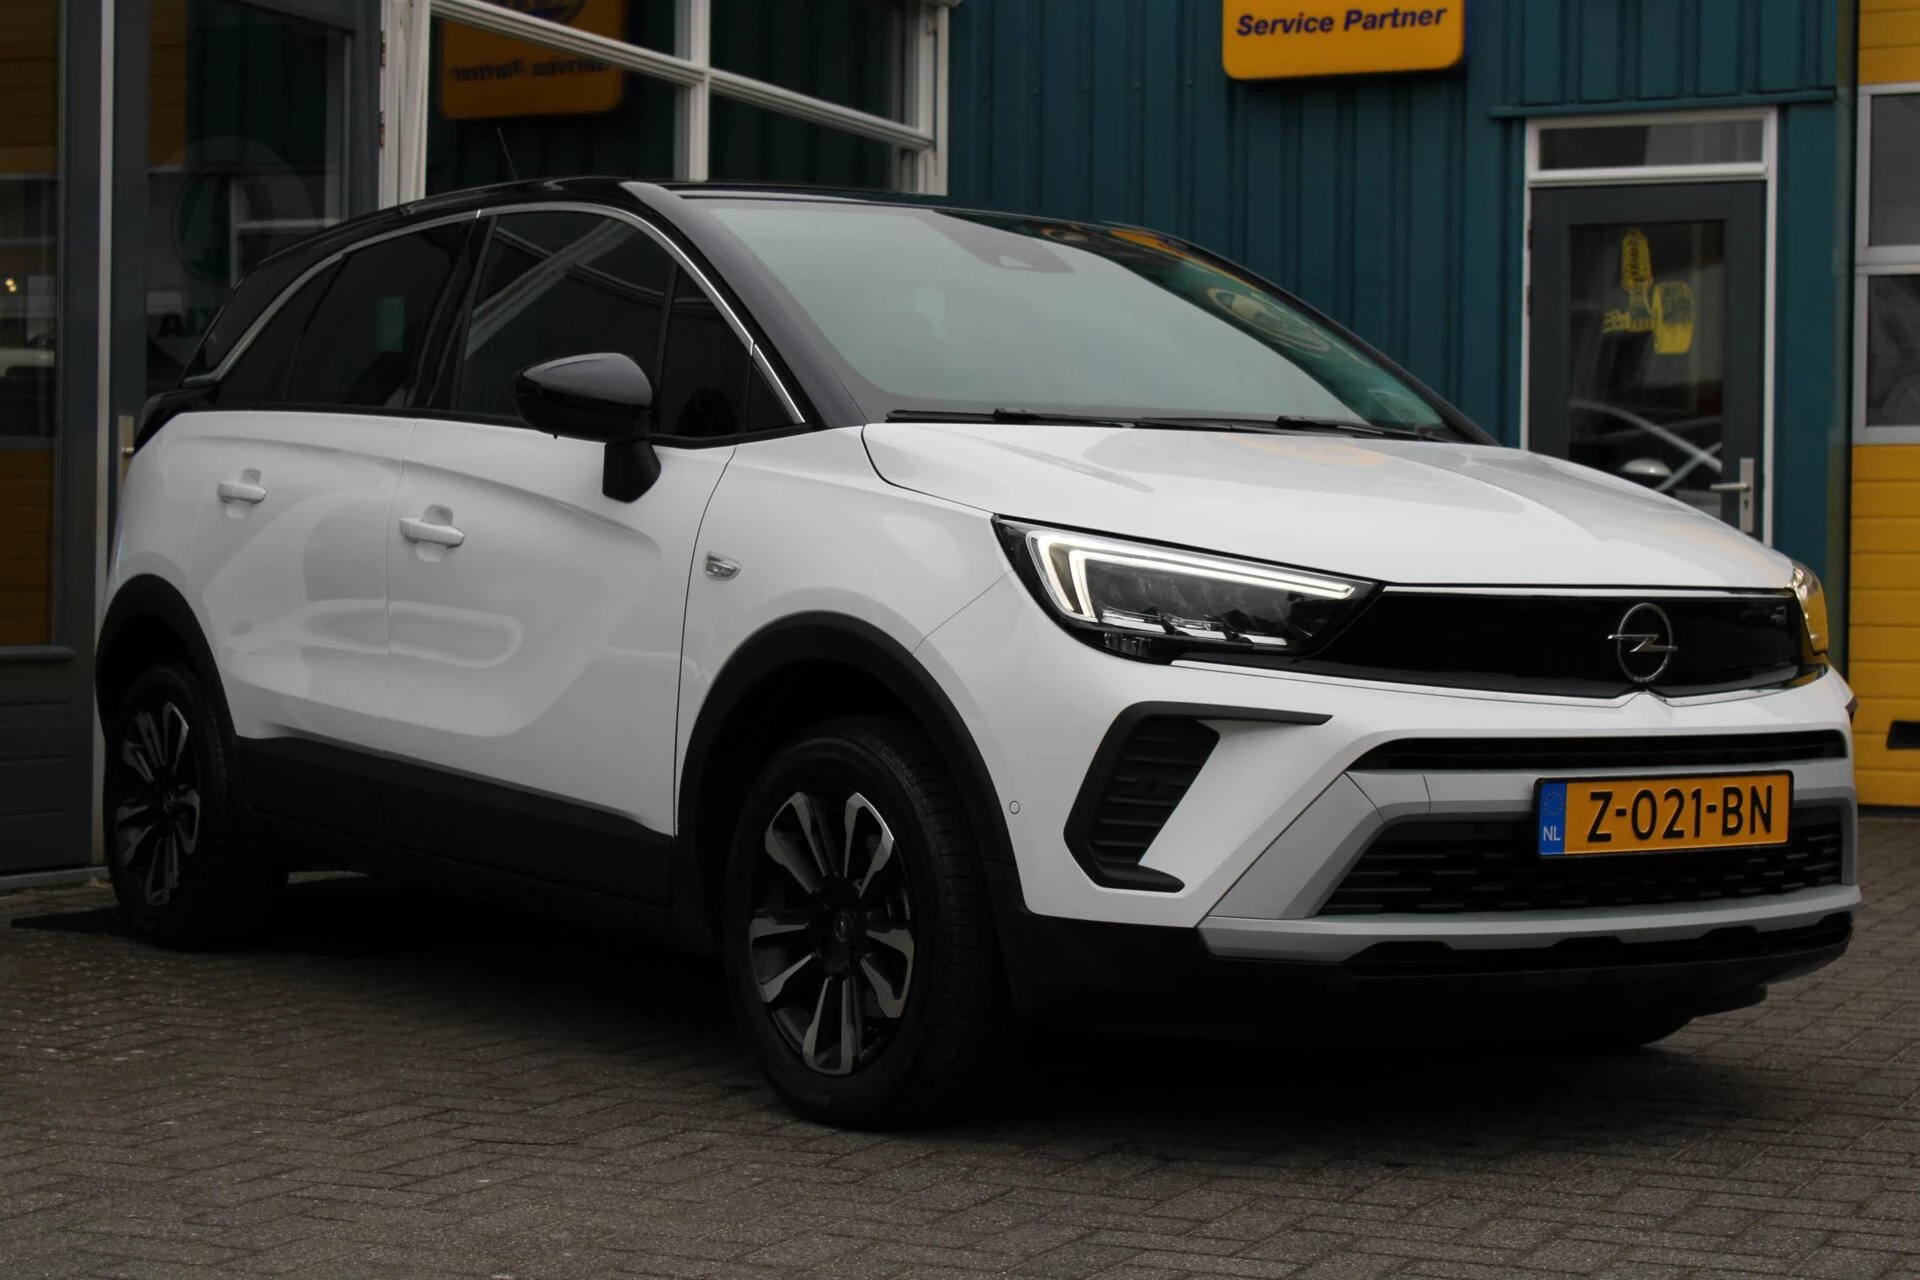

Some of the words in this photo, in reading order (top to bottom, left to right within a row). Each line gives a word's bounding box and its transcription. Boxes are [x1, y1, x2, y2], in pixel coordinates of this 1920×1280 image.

[1236, 13, 1334, 36] Service
[1343, 8, 1447, 31] Partner
[1587, 785, 1773, 842] Z-021-BN
[1542, 825, 1561, 842] NL
